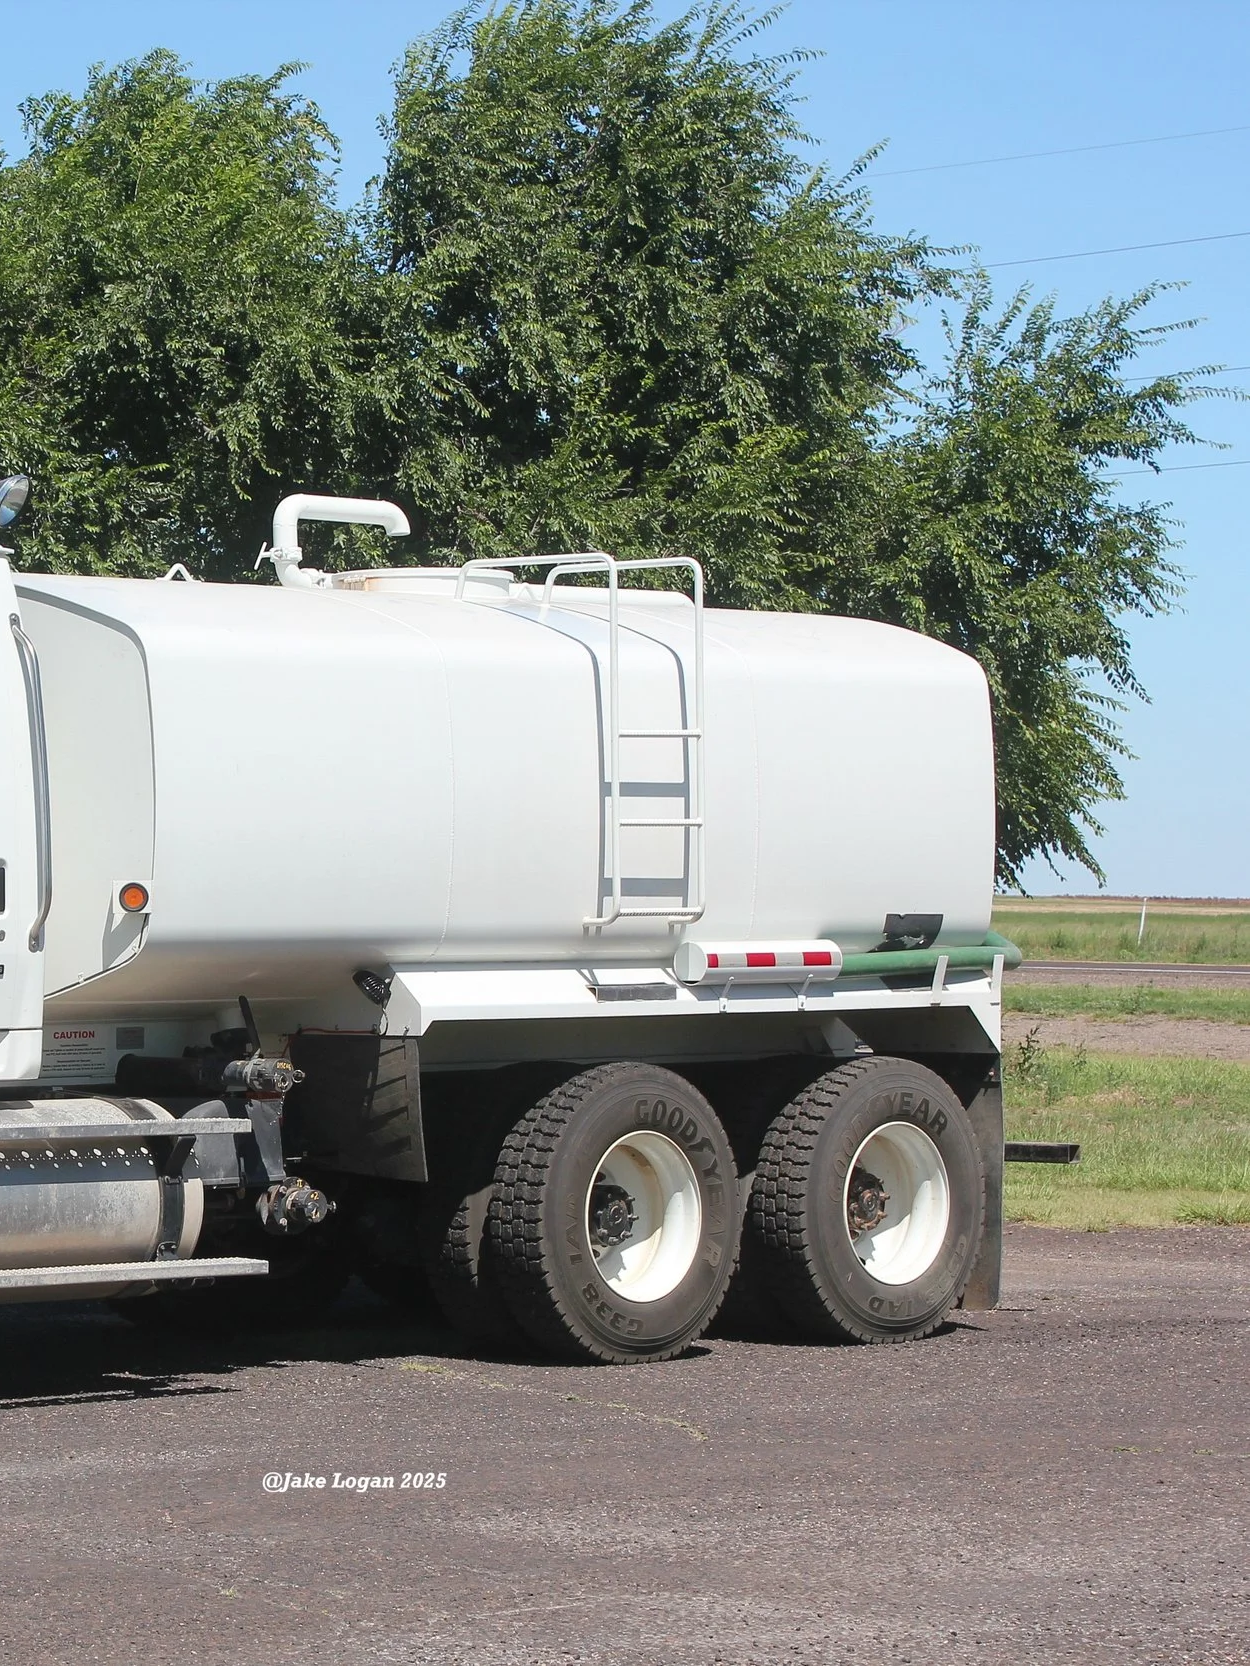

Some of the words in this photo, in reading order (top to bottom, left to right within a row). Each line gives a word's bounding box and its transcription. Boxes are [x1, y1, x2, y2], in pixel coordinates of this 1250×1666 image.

[53, 1031, 95, 1039] CAUTION
[634, 1099, 725, 1268] GOODYEAR
[582, 1282, 644, 1336] G338
